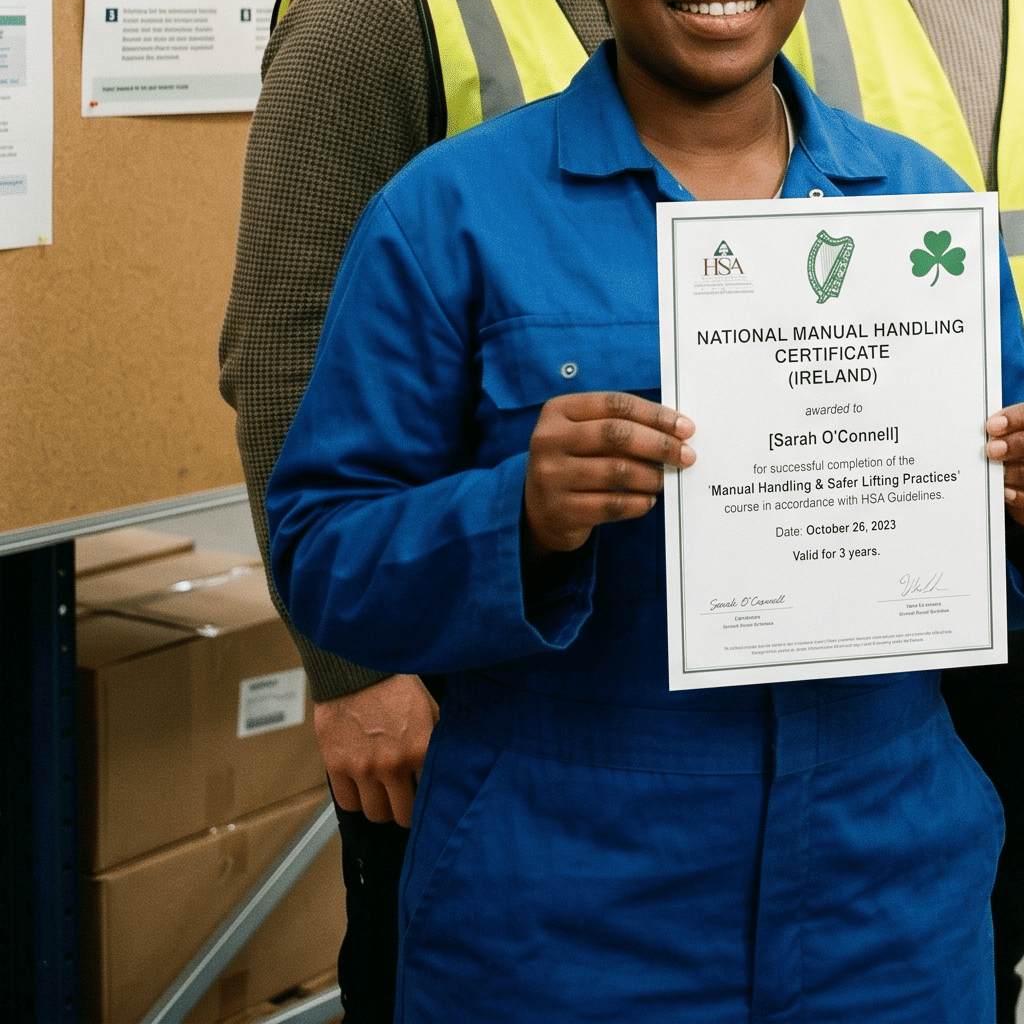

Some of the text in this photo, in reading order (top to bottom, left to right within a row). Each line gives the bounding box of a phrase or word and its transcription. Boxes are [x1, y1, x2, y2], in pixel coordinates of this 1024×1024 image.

[703, 257, 744, 276] HSA
[697, 319, 964, 346] NATIONAL MANUAL HANDLING
[774, 344, 890, 364] CERTIFICATE
[788, 367, 878, 390] (IRELAND)
[805, 402, 863, 417] awarded to
[769, 426, 899, 451] [Sarah O'Connell]
[753, 455, 915, 475] for successful completion of the
[758, 479, 812, 494] Handling
[815, 478, 824, 490] &
[827, 476, 859, 490] Safer
[862, 474, 899, 489] Lifting
[724, 490, 945, 514] course in accordance with HSA Guidelines.
[775, 519, 897, 538] Date: October 26, 2023
[792, 547, 881, 562] Valid for 3 years.
